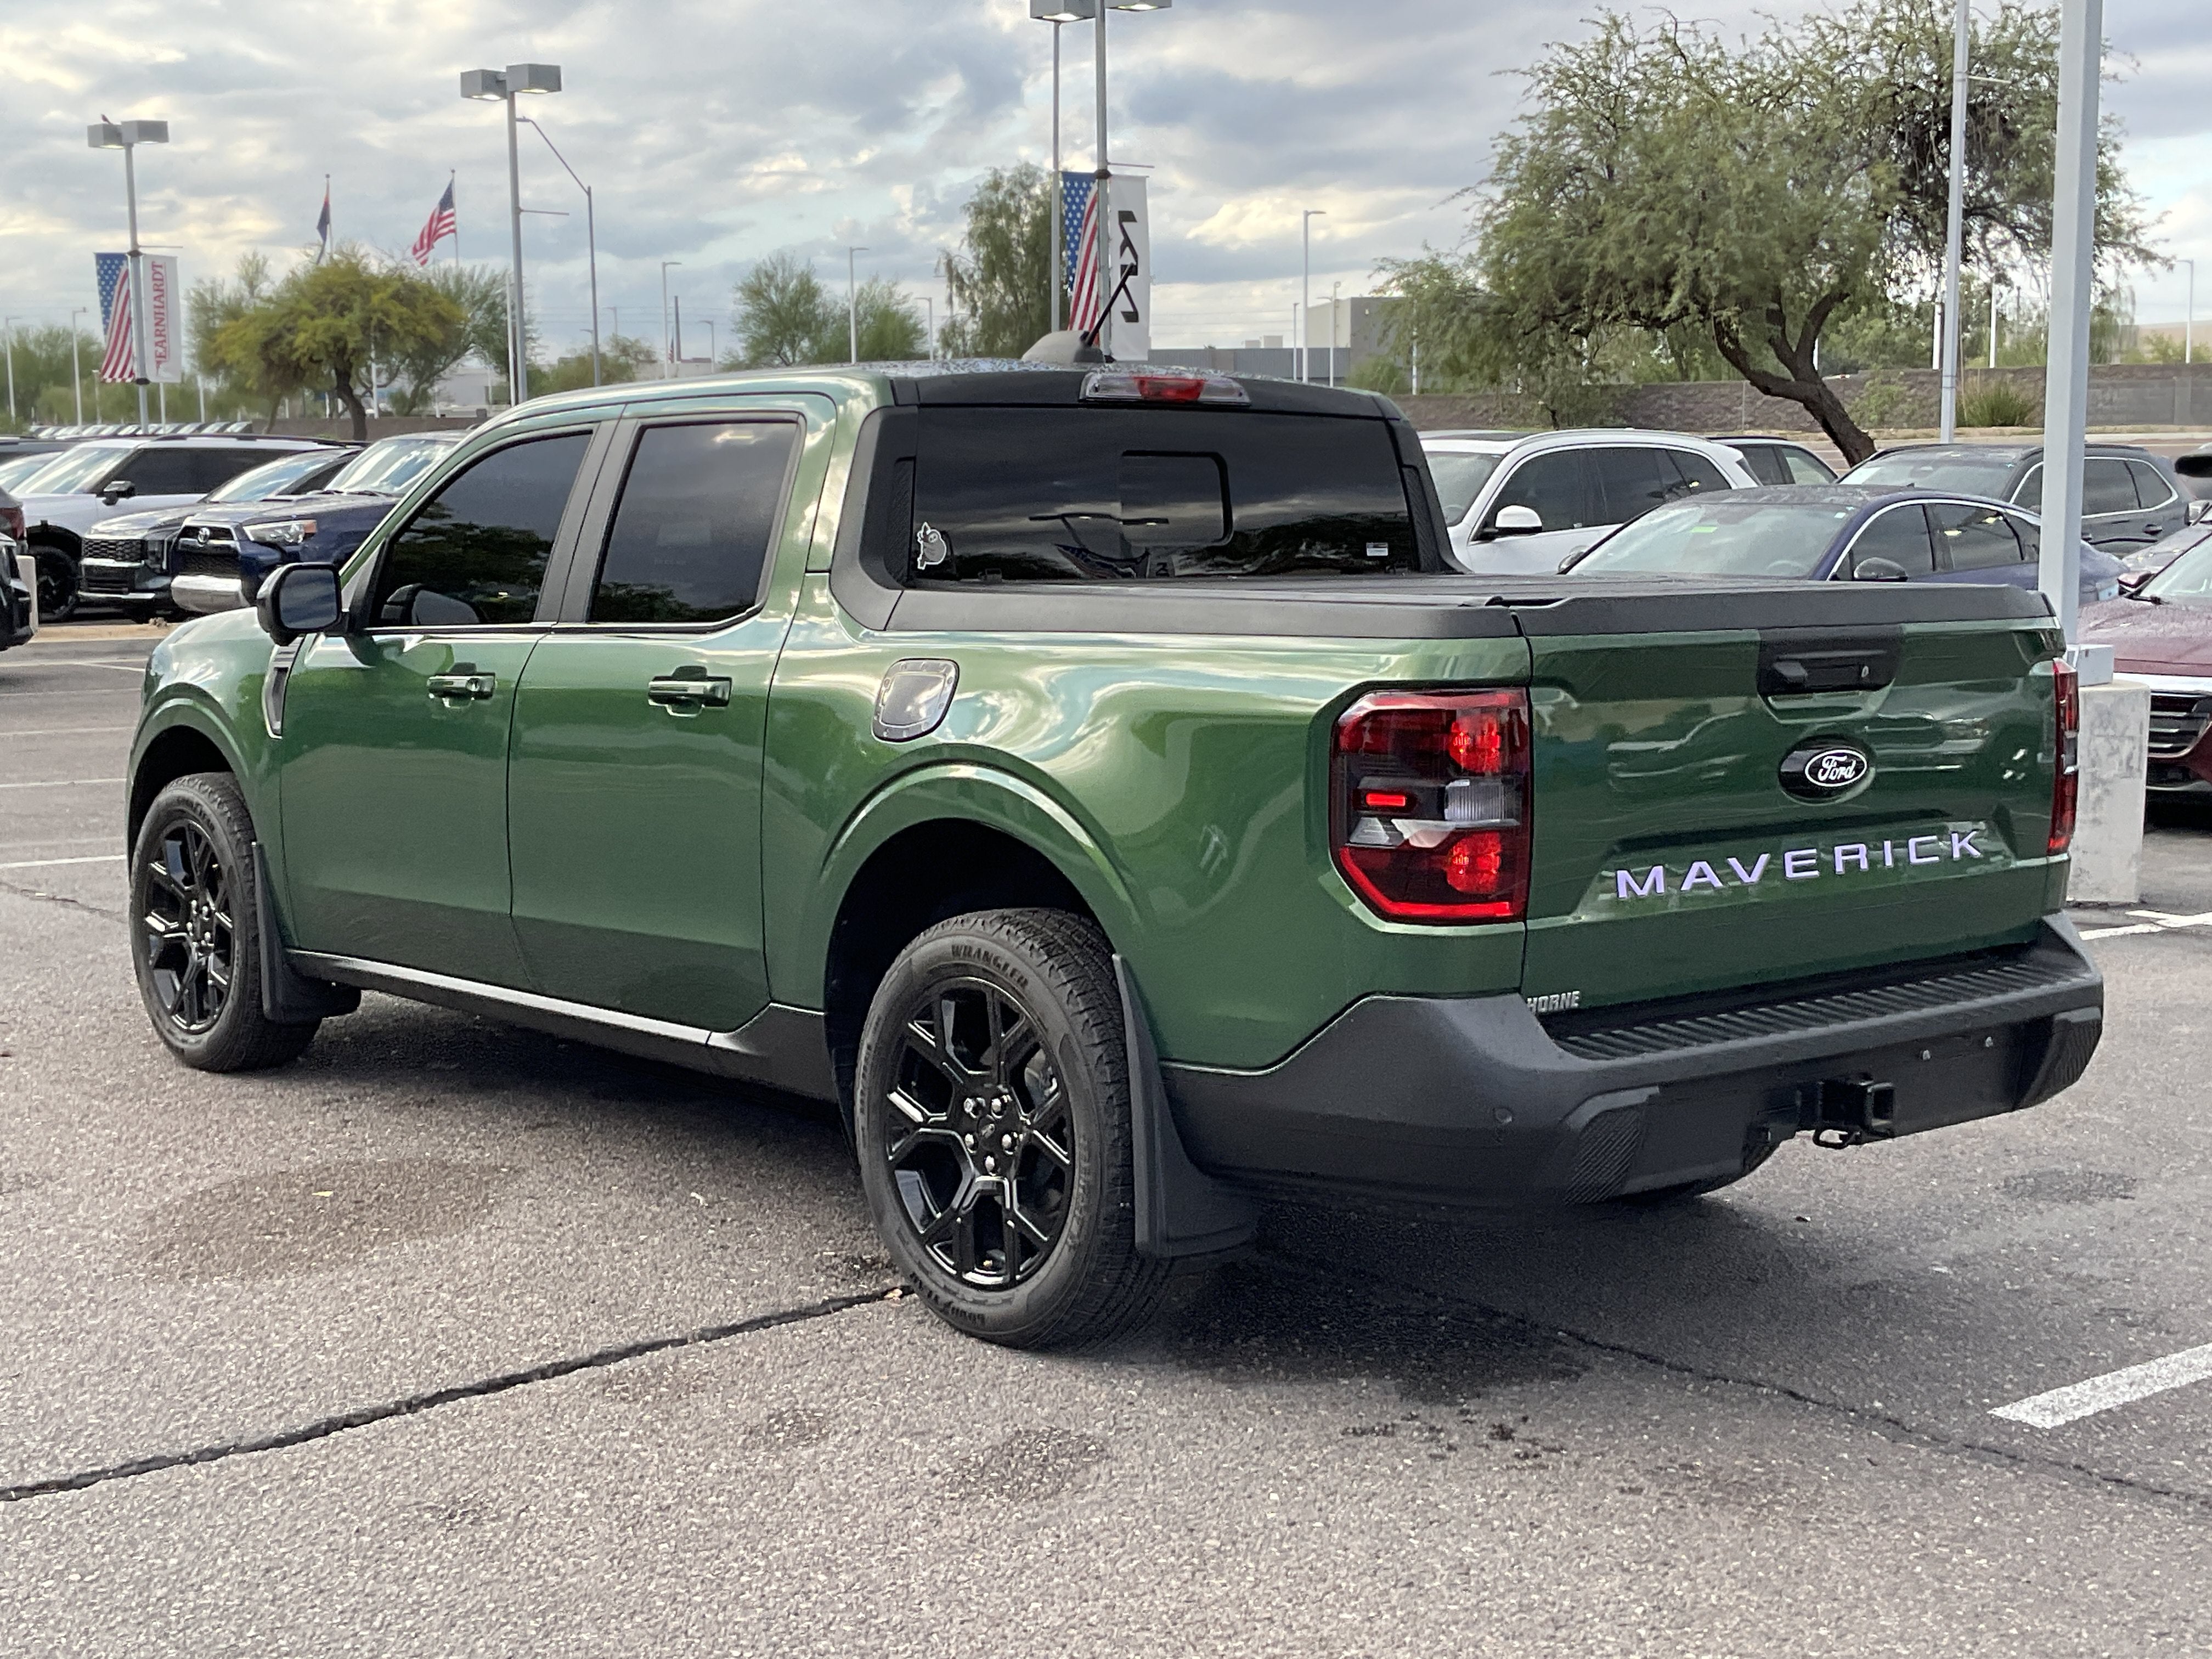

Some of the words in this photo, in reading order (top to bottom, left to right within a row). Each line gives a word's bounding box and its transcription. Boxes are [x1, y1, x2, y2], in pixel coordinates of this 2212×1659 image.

[151, 261, 167, 360] EARNHARDT
[1816, 754, 1858, 782] Ford
[1616, 830, 1982, 899] MAVERICK
[1526, 990, 1580, 1013] HORNE
